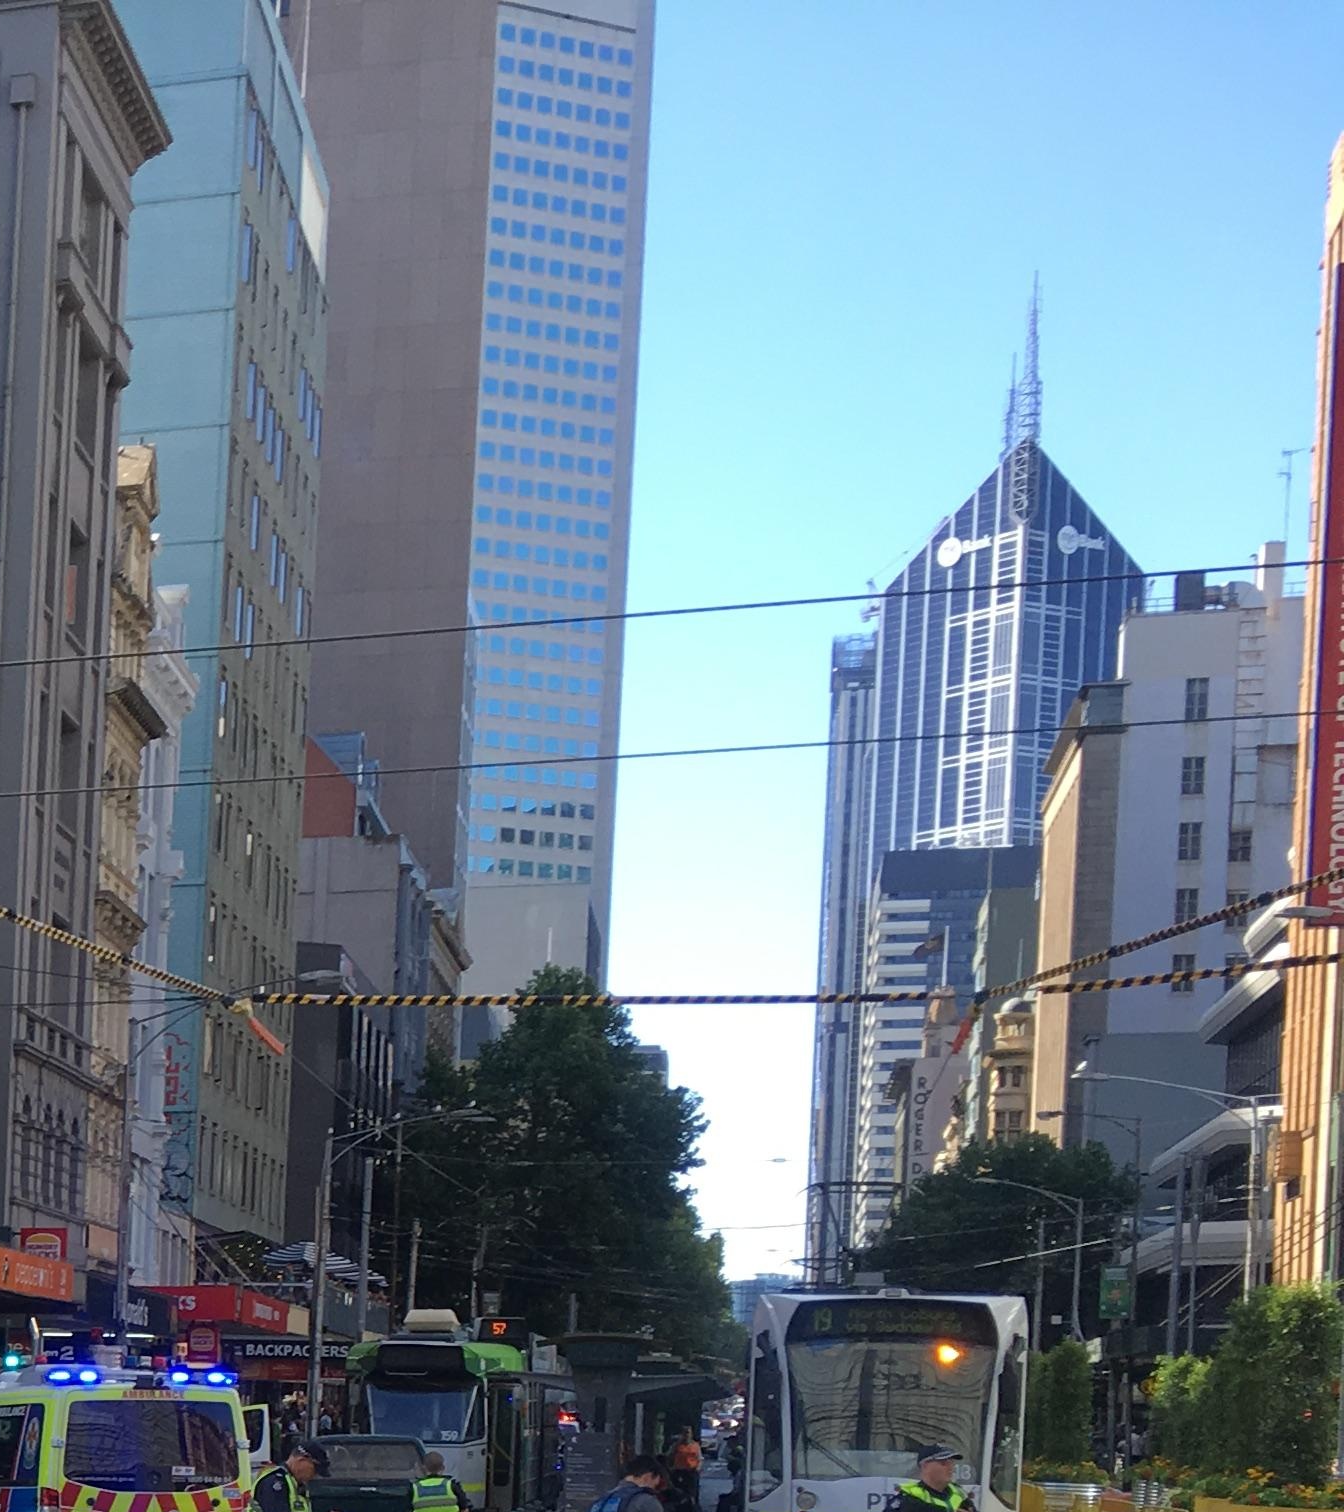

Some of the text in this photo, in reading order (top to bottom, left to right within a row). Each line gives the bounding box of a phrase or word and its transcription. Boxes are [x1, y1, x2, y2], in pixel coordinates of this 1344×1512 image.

[493, 1322, 507, 1335] 57
[245, 1343, 349, 1358] BACKPACERS
[121, 1390, 185, 1400] AMBULANCE
